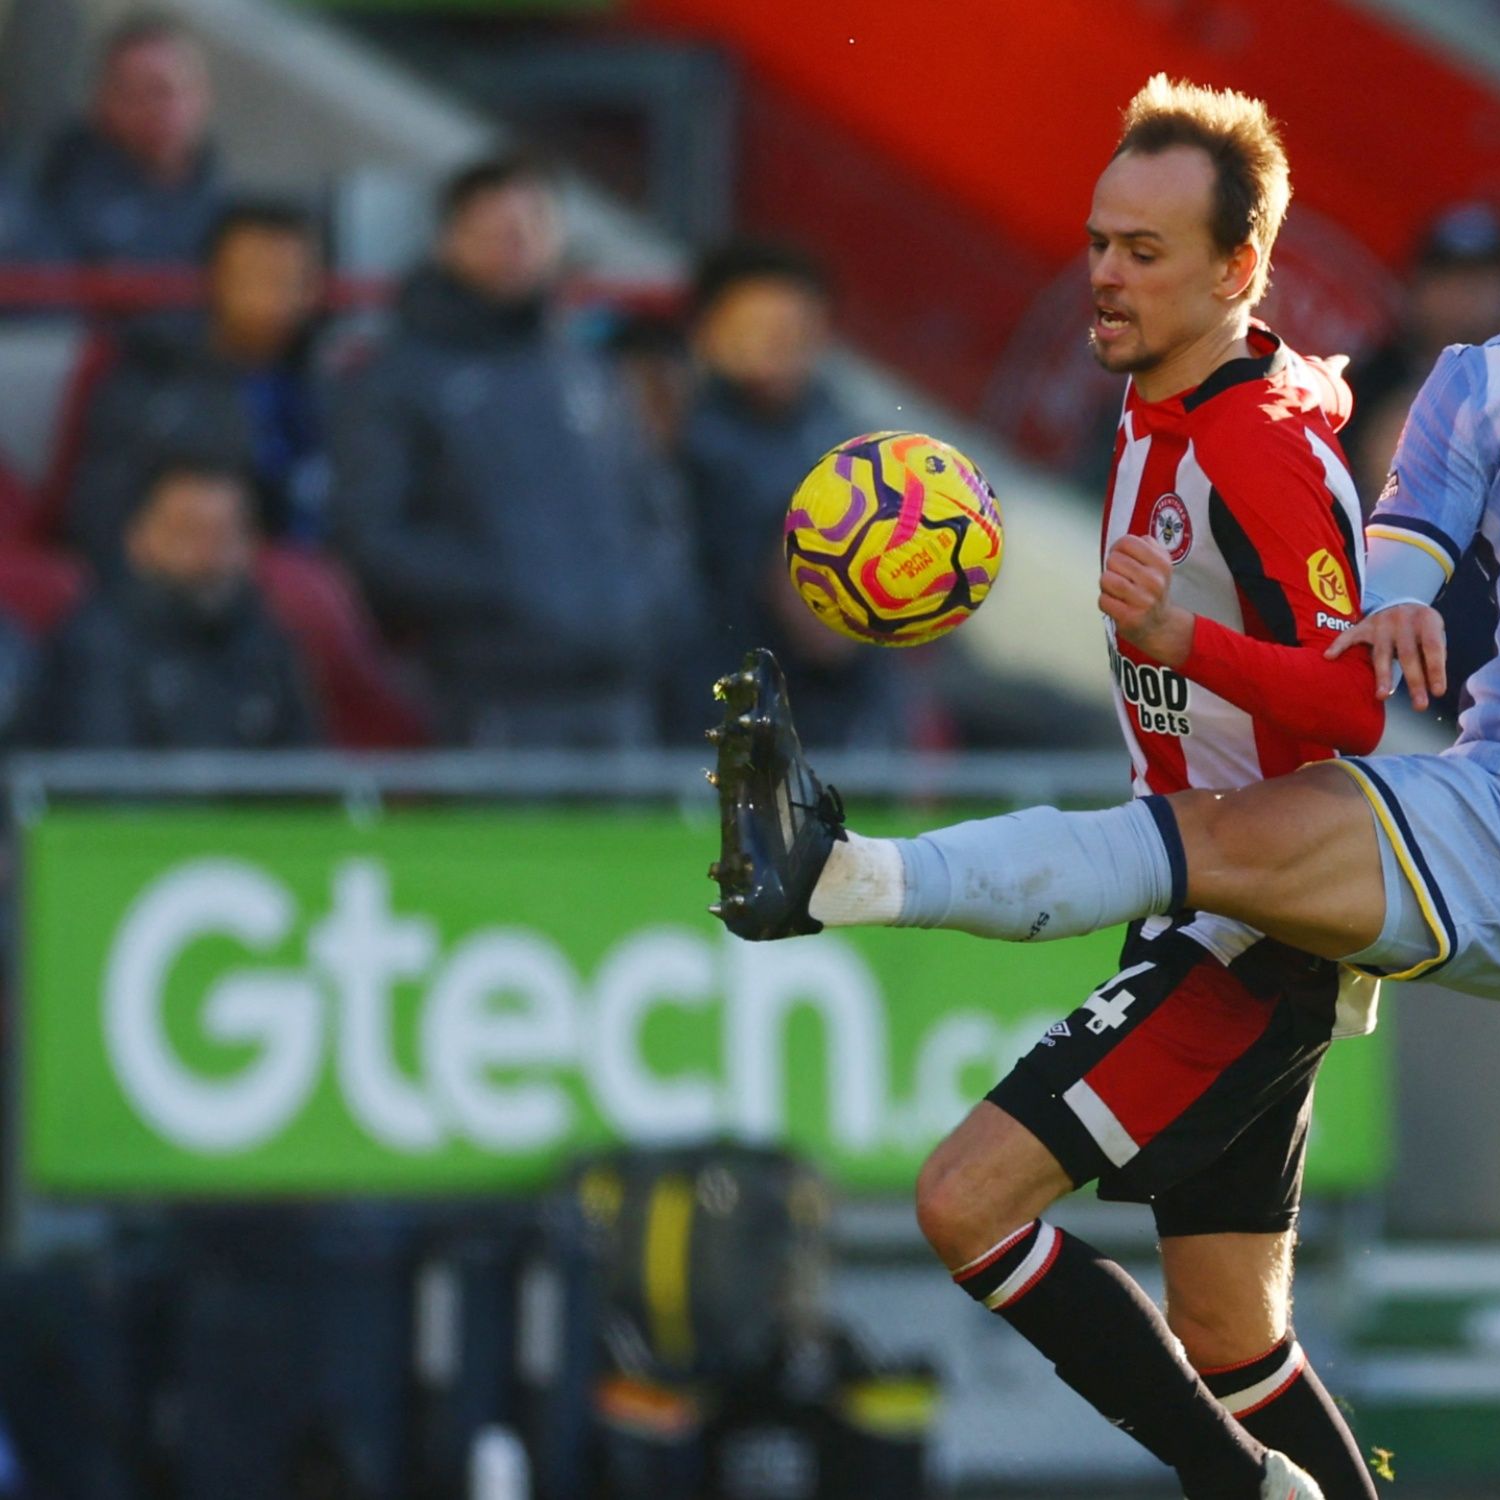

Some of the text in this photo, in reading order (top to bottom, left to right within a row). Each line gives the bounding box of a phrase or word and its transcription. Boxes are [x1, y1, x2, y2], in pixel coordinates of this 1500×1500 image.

[1316, 611, 1355, 632] Pens
[1140, 705, 1190, 735] bets
[103, 858, 1055, 1154] Gtech.c
